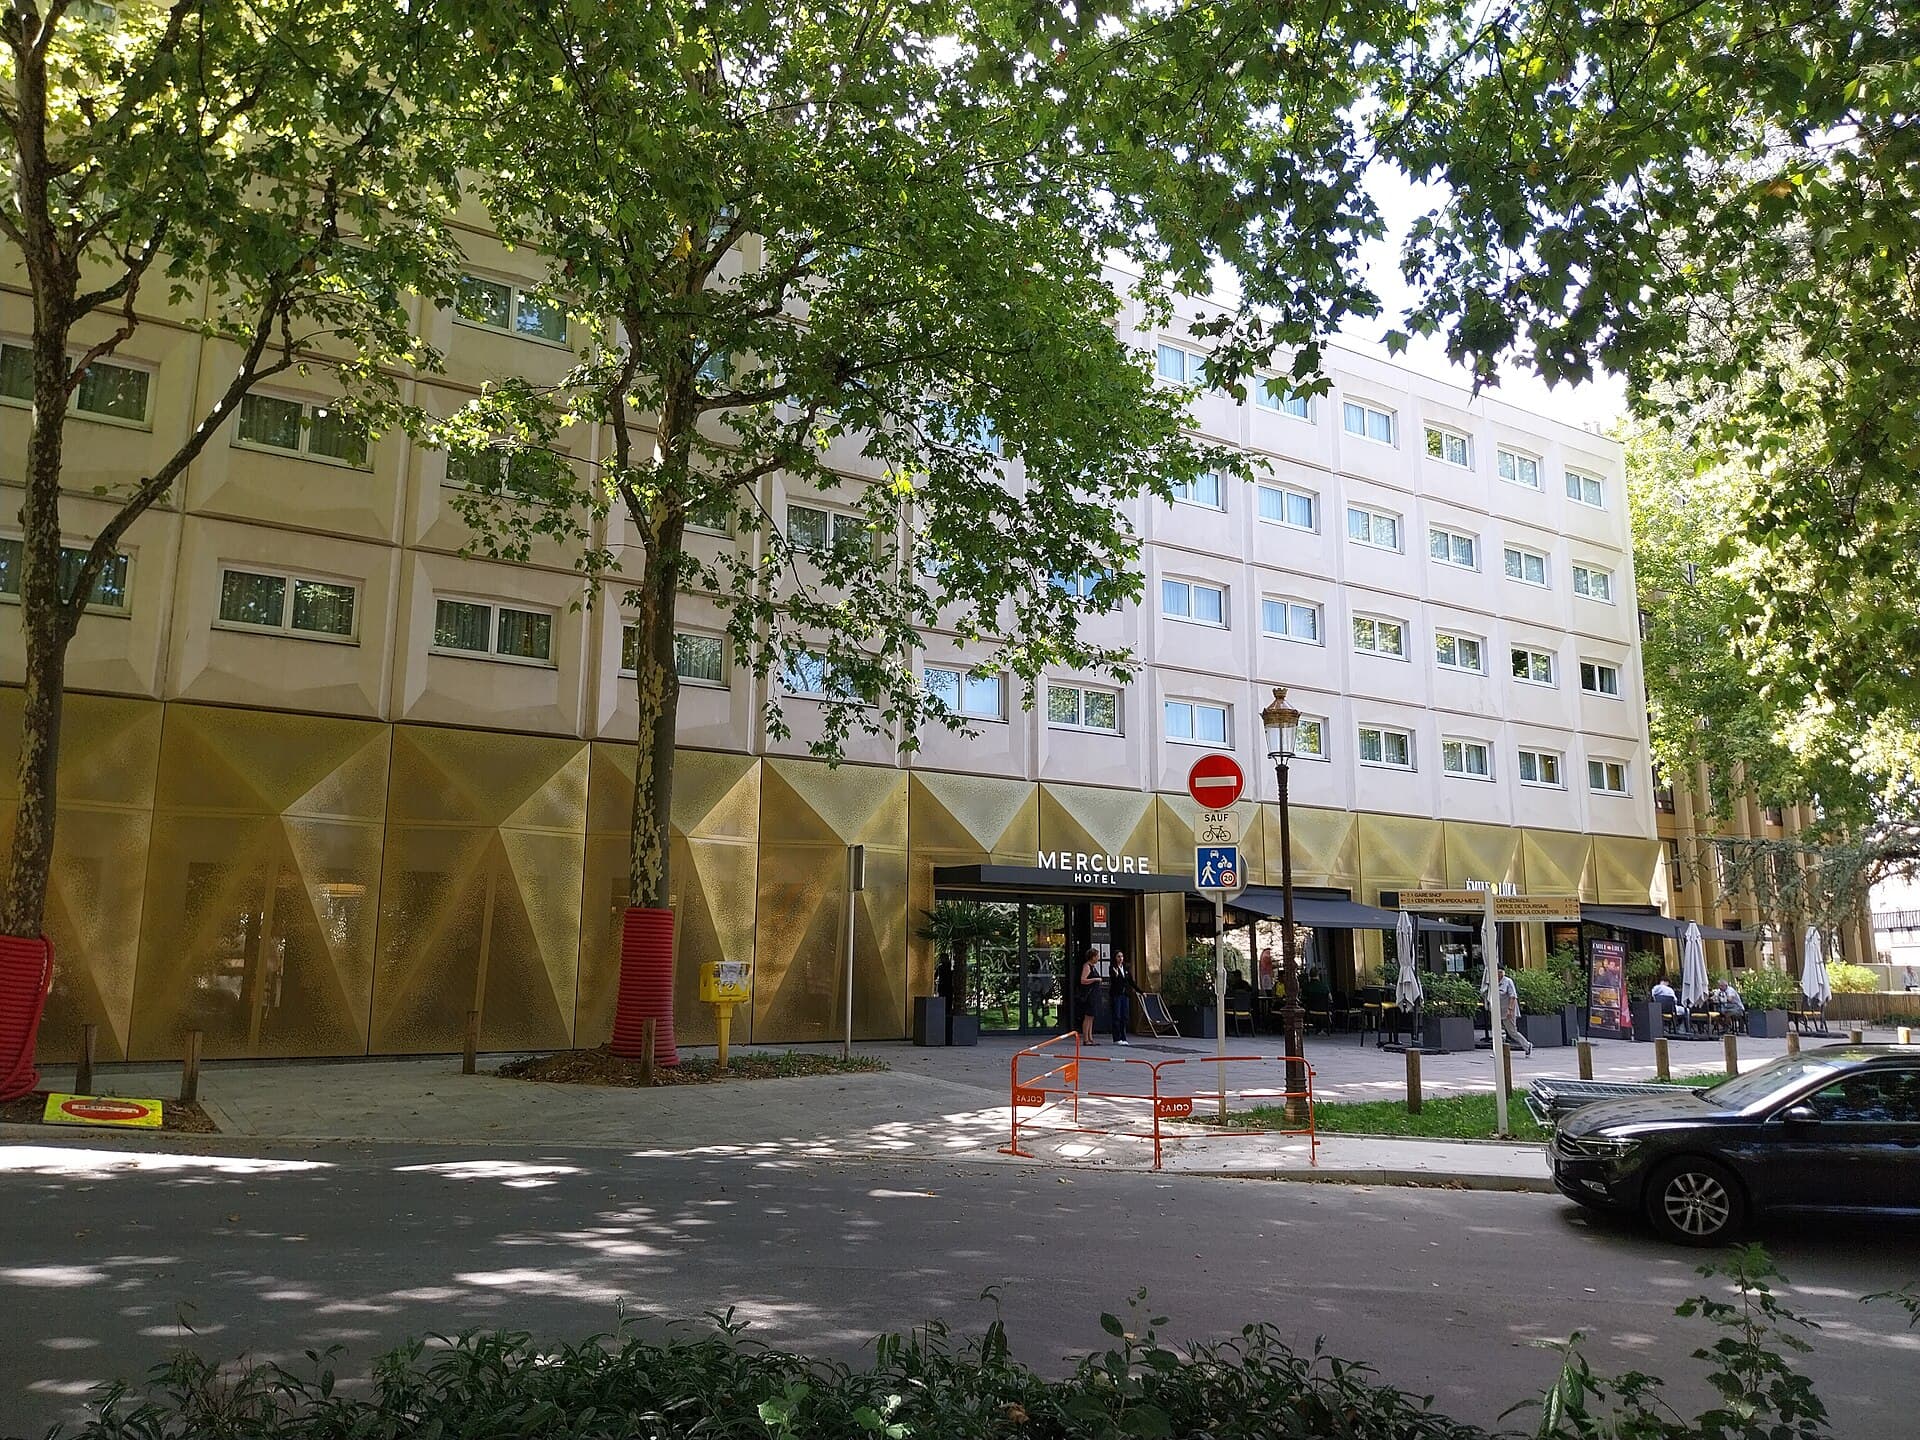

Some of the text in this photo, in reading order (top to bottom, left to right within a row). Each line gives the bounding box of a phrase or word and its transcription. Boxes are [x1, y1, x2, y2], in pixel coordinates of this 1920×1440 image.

[1204, 813, 1229, 822] SAUF
[1037, 850, 1150, 875] MERCURE
[1074, 873, 1117, 885] HOTEL
